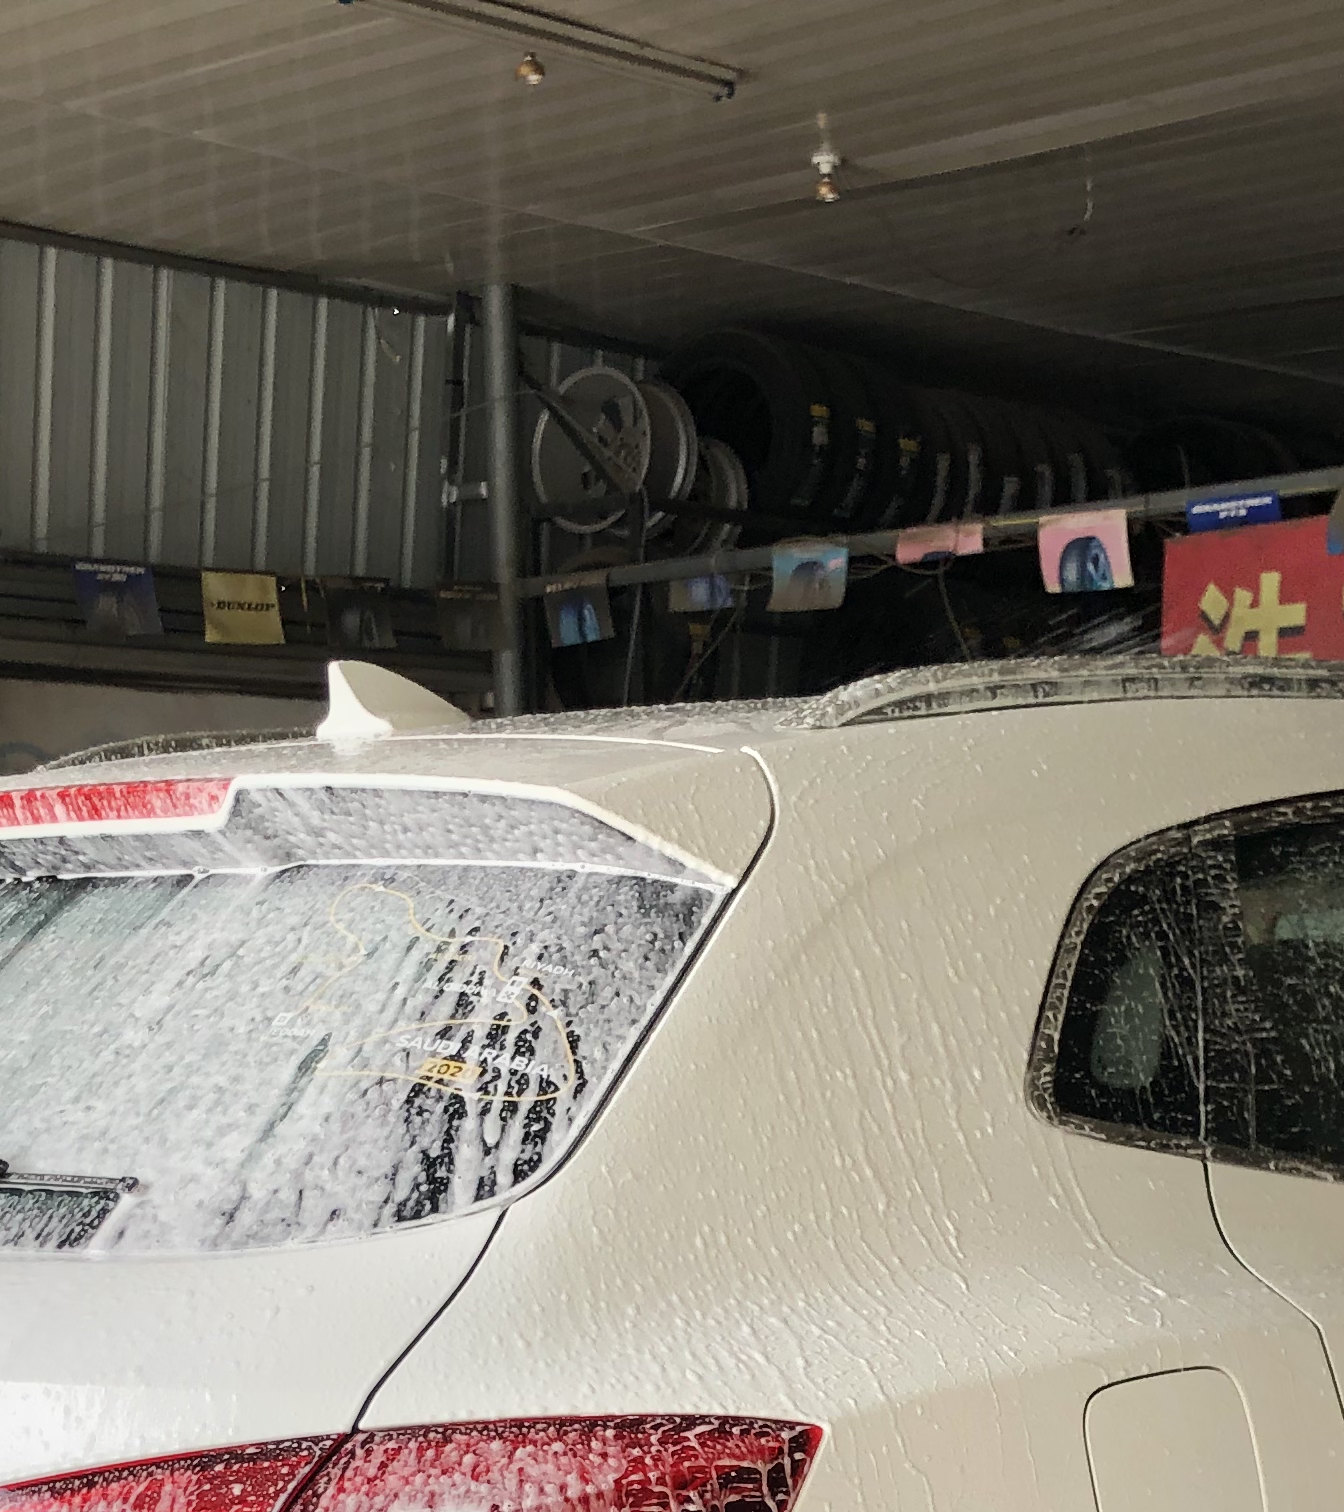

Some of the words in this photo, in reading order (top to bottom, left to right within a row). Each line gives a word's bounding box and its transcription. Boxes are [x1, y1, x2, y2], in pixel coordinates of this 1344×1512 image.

[213, 600, 276, 613] DUNLOP
[521, 958, 576, 977] RIYADH
[395, 1034, 463, 1055] SAUDI
[462, 1045, 553, 1079] ARABIA
